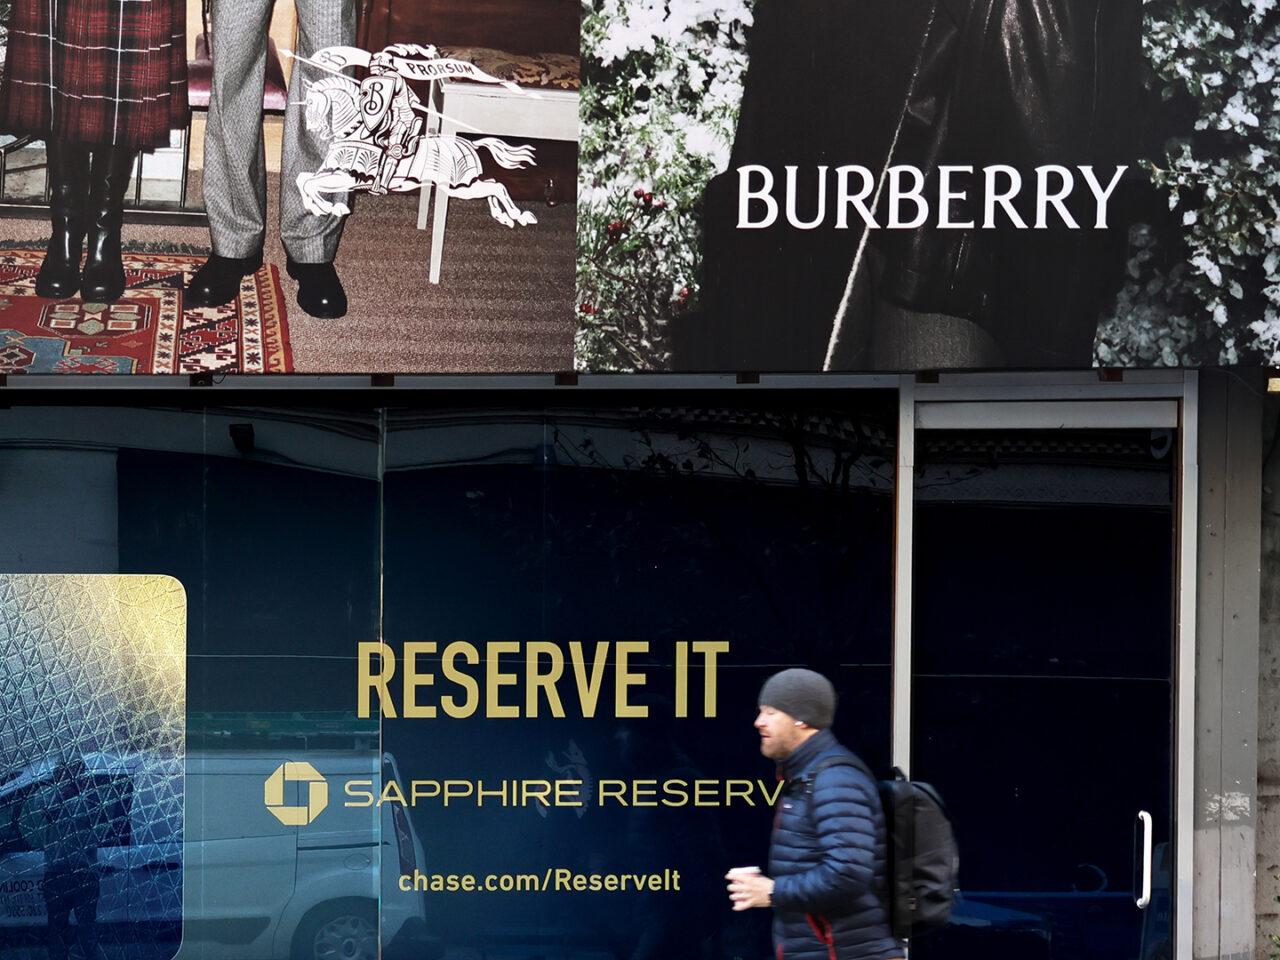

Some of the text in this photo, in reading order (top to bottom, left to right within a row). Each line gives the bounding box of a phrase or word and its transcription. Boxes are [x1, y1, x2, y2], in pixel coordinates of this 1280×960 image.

[406, 62, 475, 76] PRORSUM
[736, 164, 1129, 230] BURBERRY
[357, 640, 730, 719] RESERVE IT
[344, 779, 785, 807] SAPPHIRE RESERV
[398, 867, 681, 893] chase.com/ReserveIt
